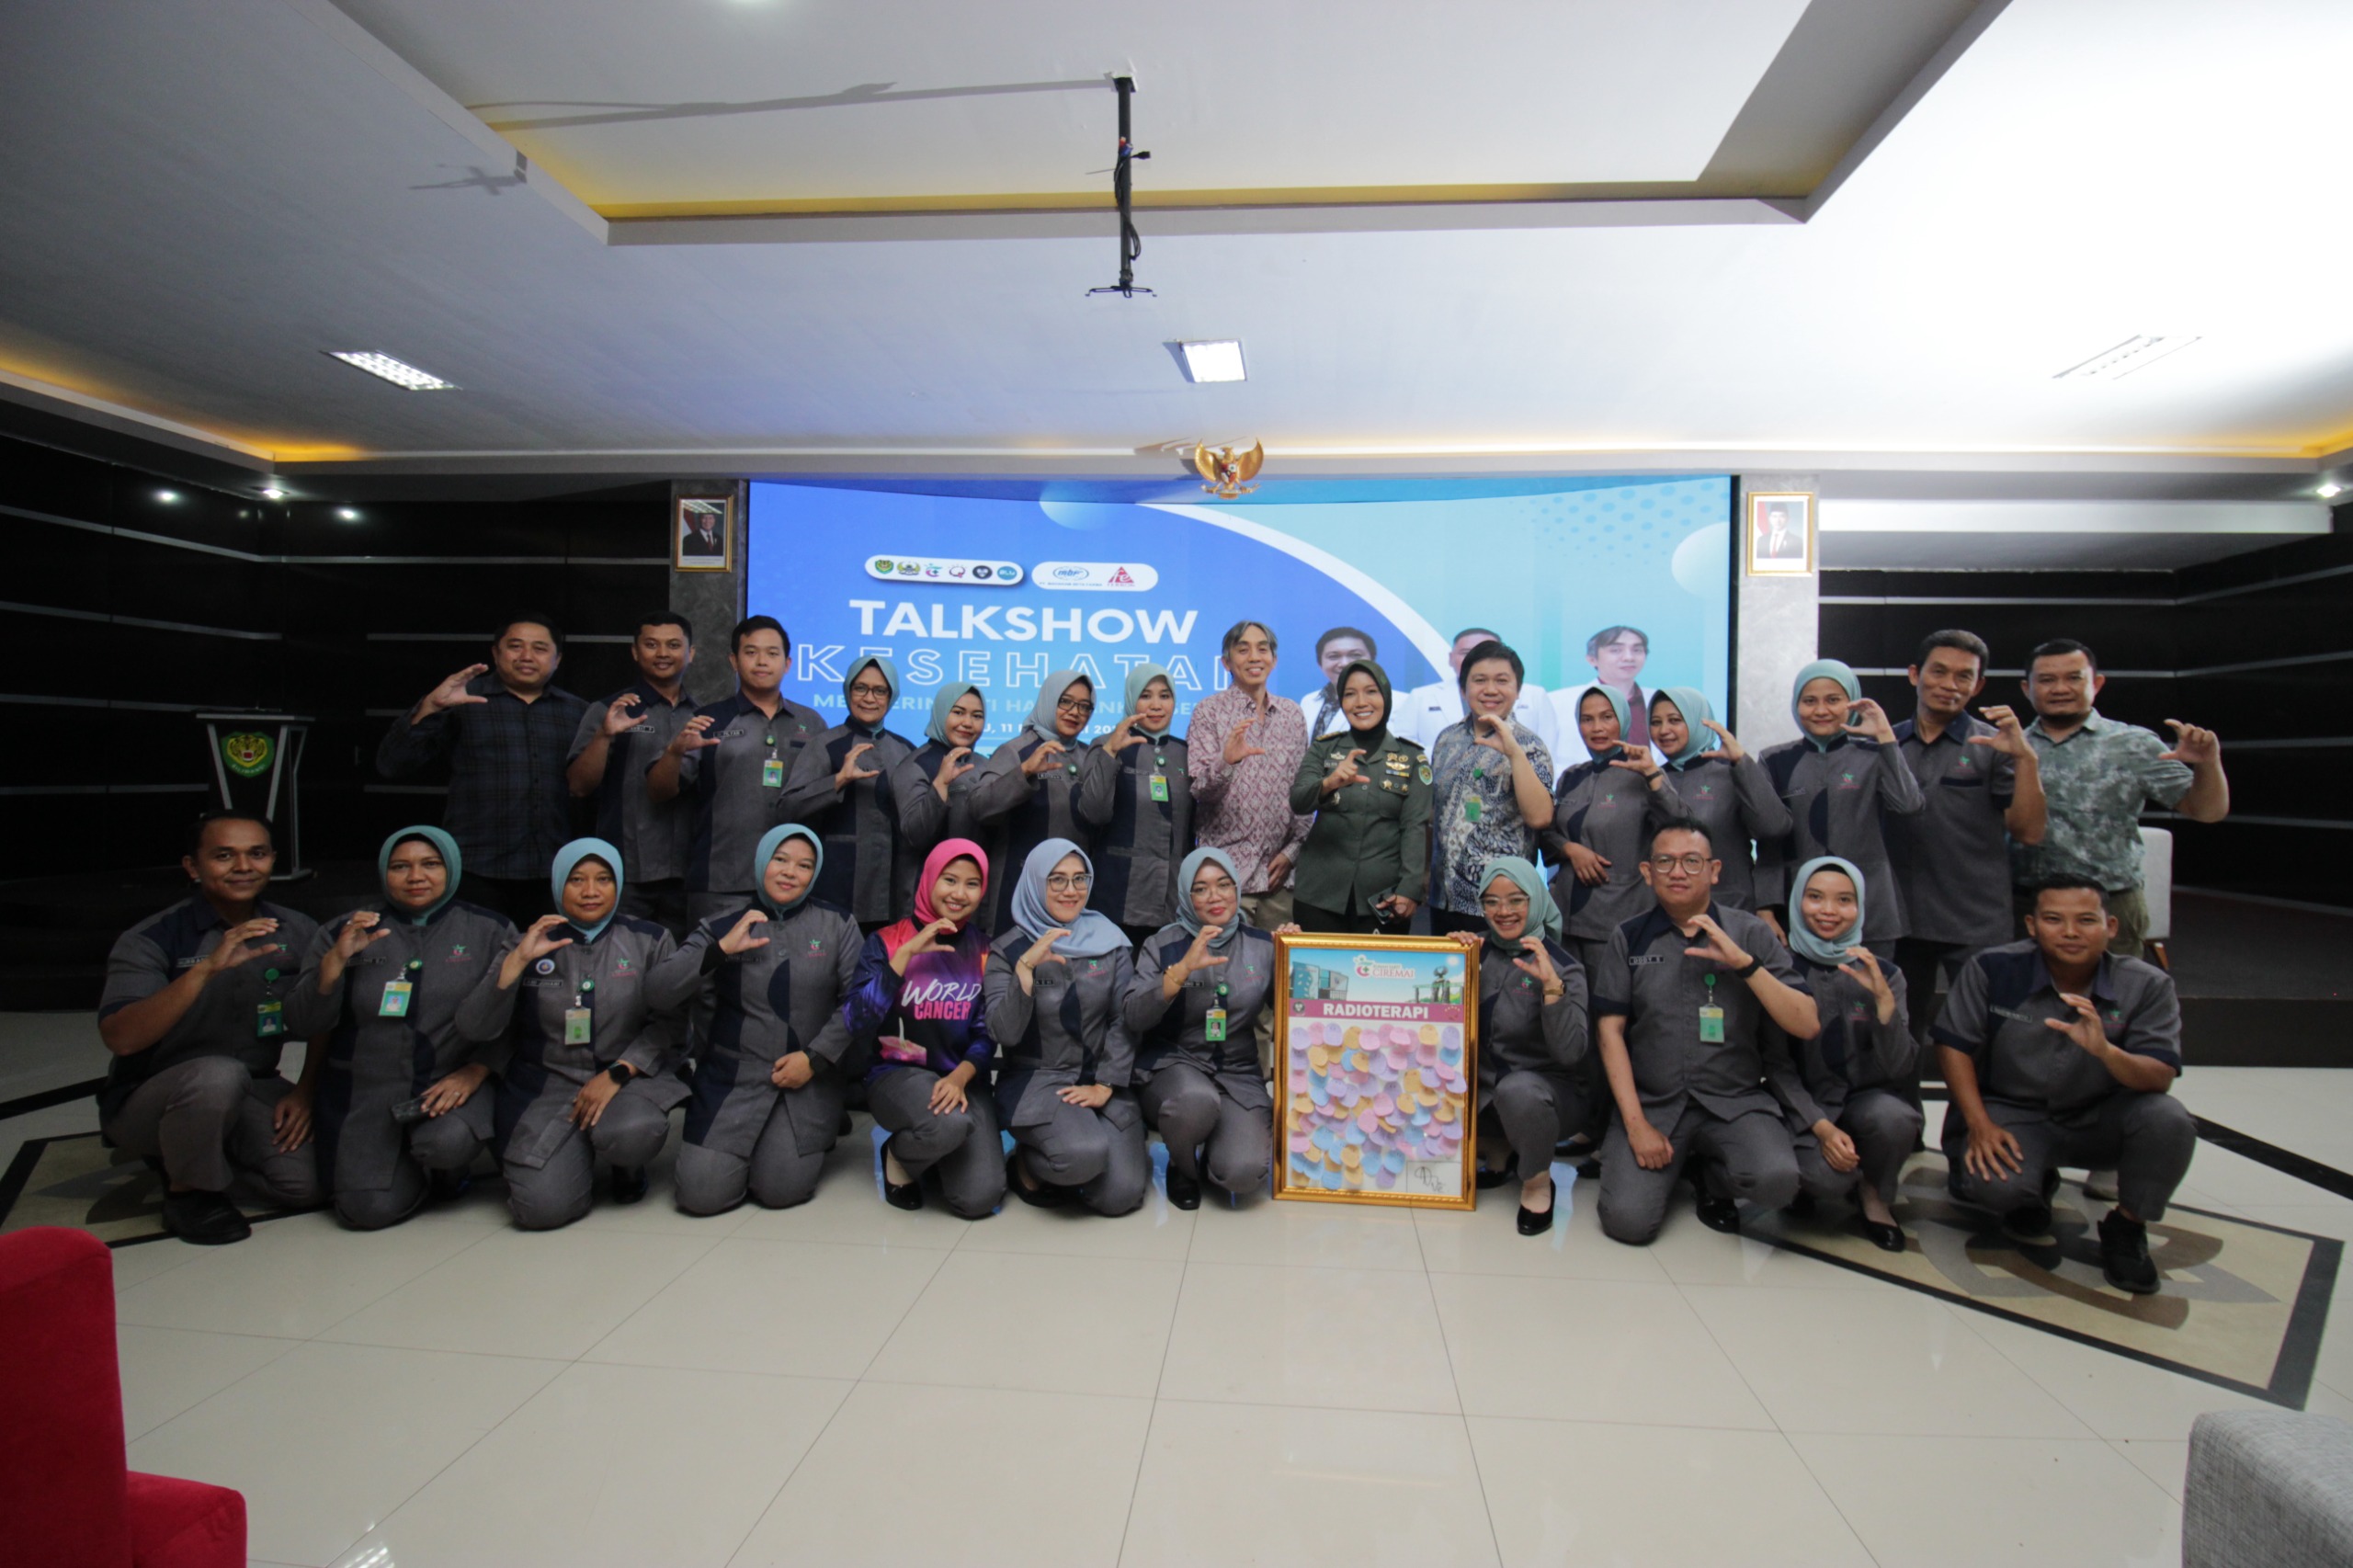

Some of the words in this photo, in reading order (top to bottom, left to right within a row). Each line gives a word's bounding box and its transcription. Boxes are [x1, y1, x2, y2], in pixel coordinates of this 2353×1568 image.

[848, 599, 1199, 644] TALKSHOW
[797, 643, 1234, 691] KSEHATA
[1372, 968, 1415, 978] CIREMAI
[901, 978, 983, 1007] WORLD
[914, 1000, 972, 1020] CANCER
[1323, 1002, 1429, 1019] RADIOTERAPI
